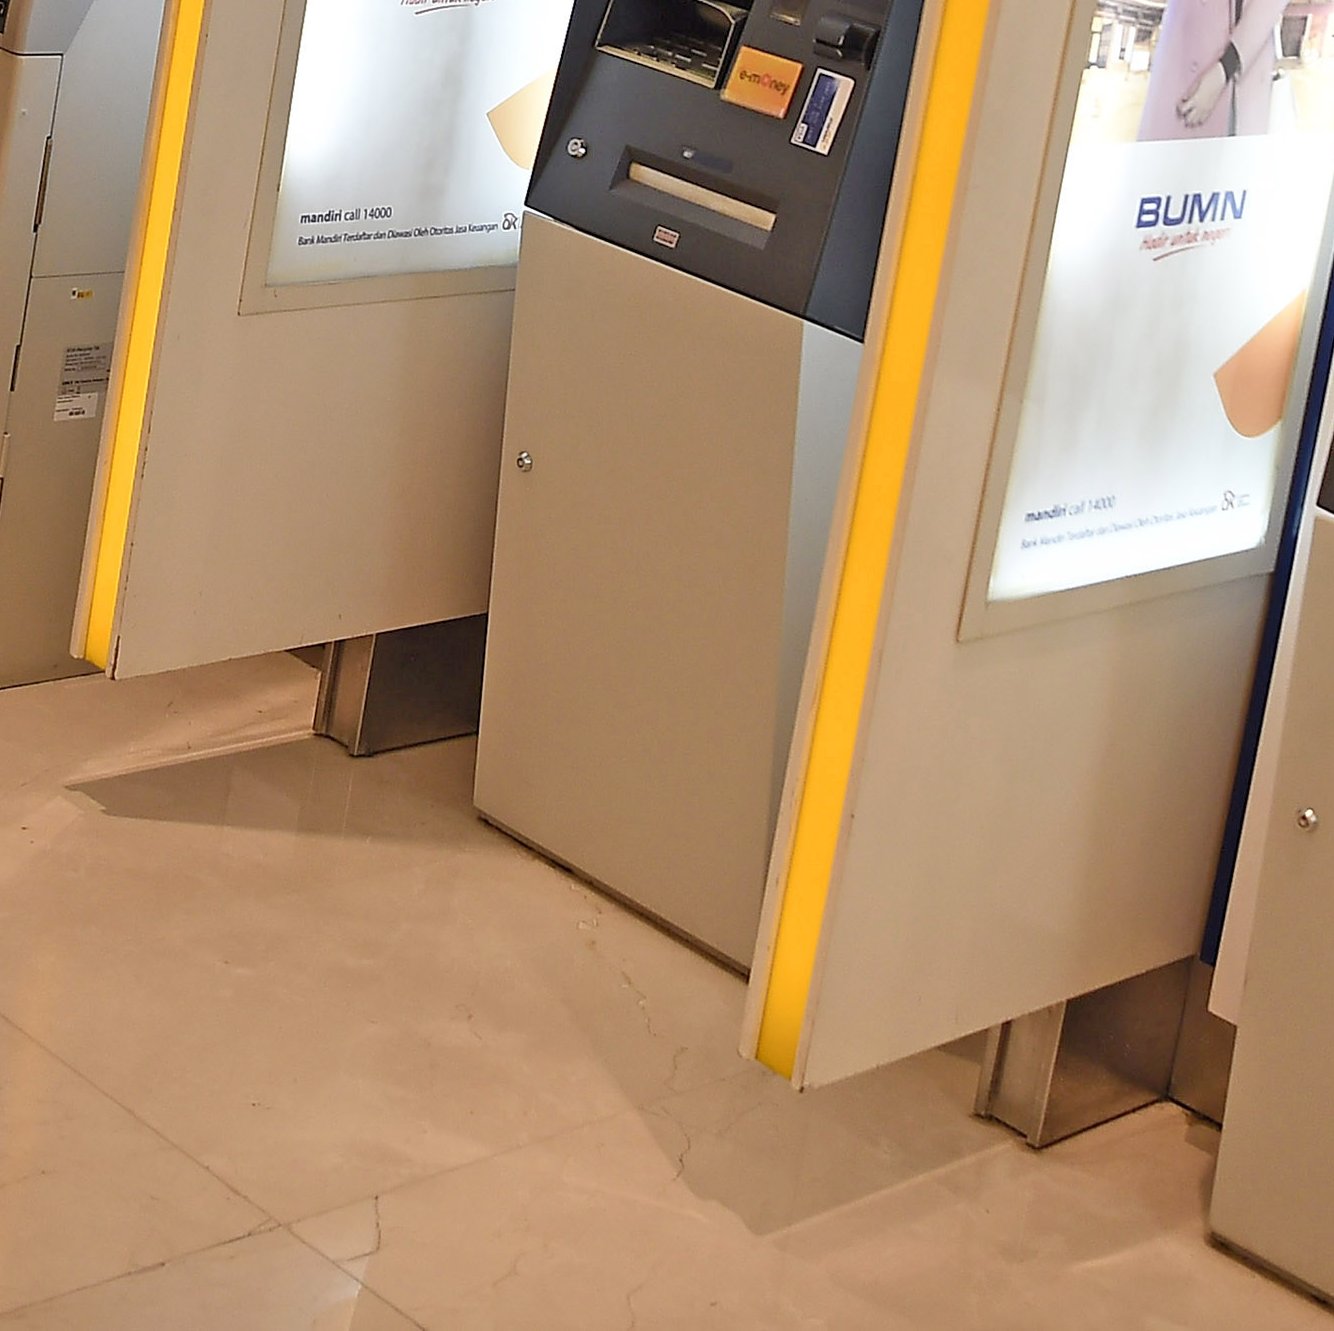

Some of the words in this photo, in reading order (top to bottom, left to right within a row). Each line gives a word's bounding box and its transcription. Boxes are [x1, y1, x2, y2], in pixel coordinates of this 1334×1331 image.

[300, 210, 342, 224] mandiri
[344, 209, 360, 221] call
[363, 207, 392, 219] 14000
[1136, 189, 1247, 229] BUMN
